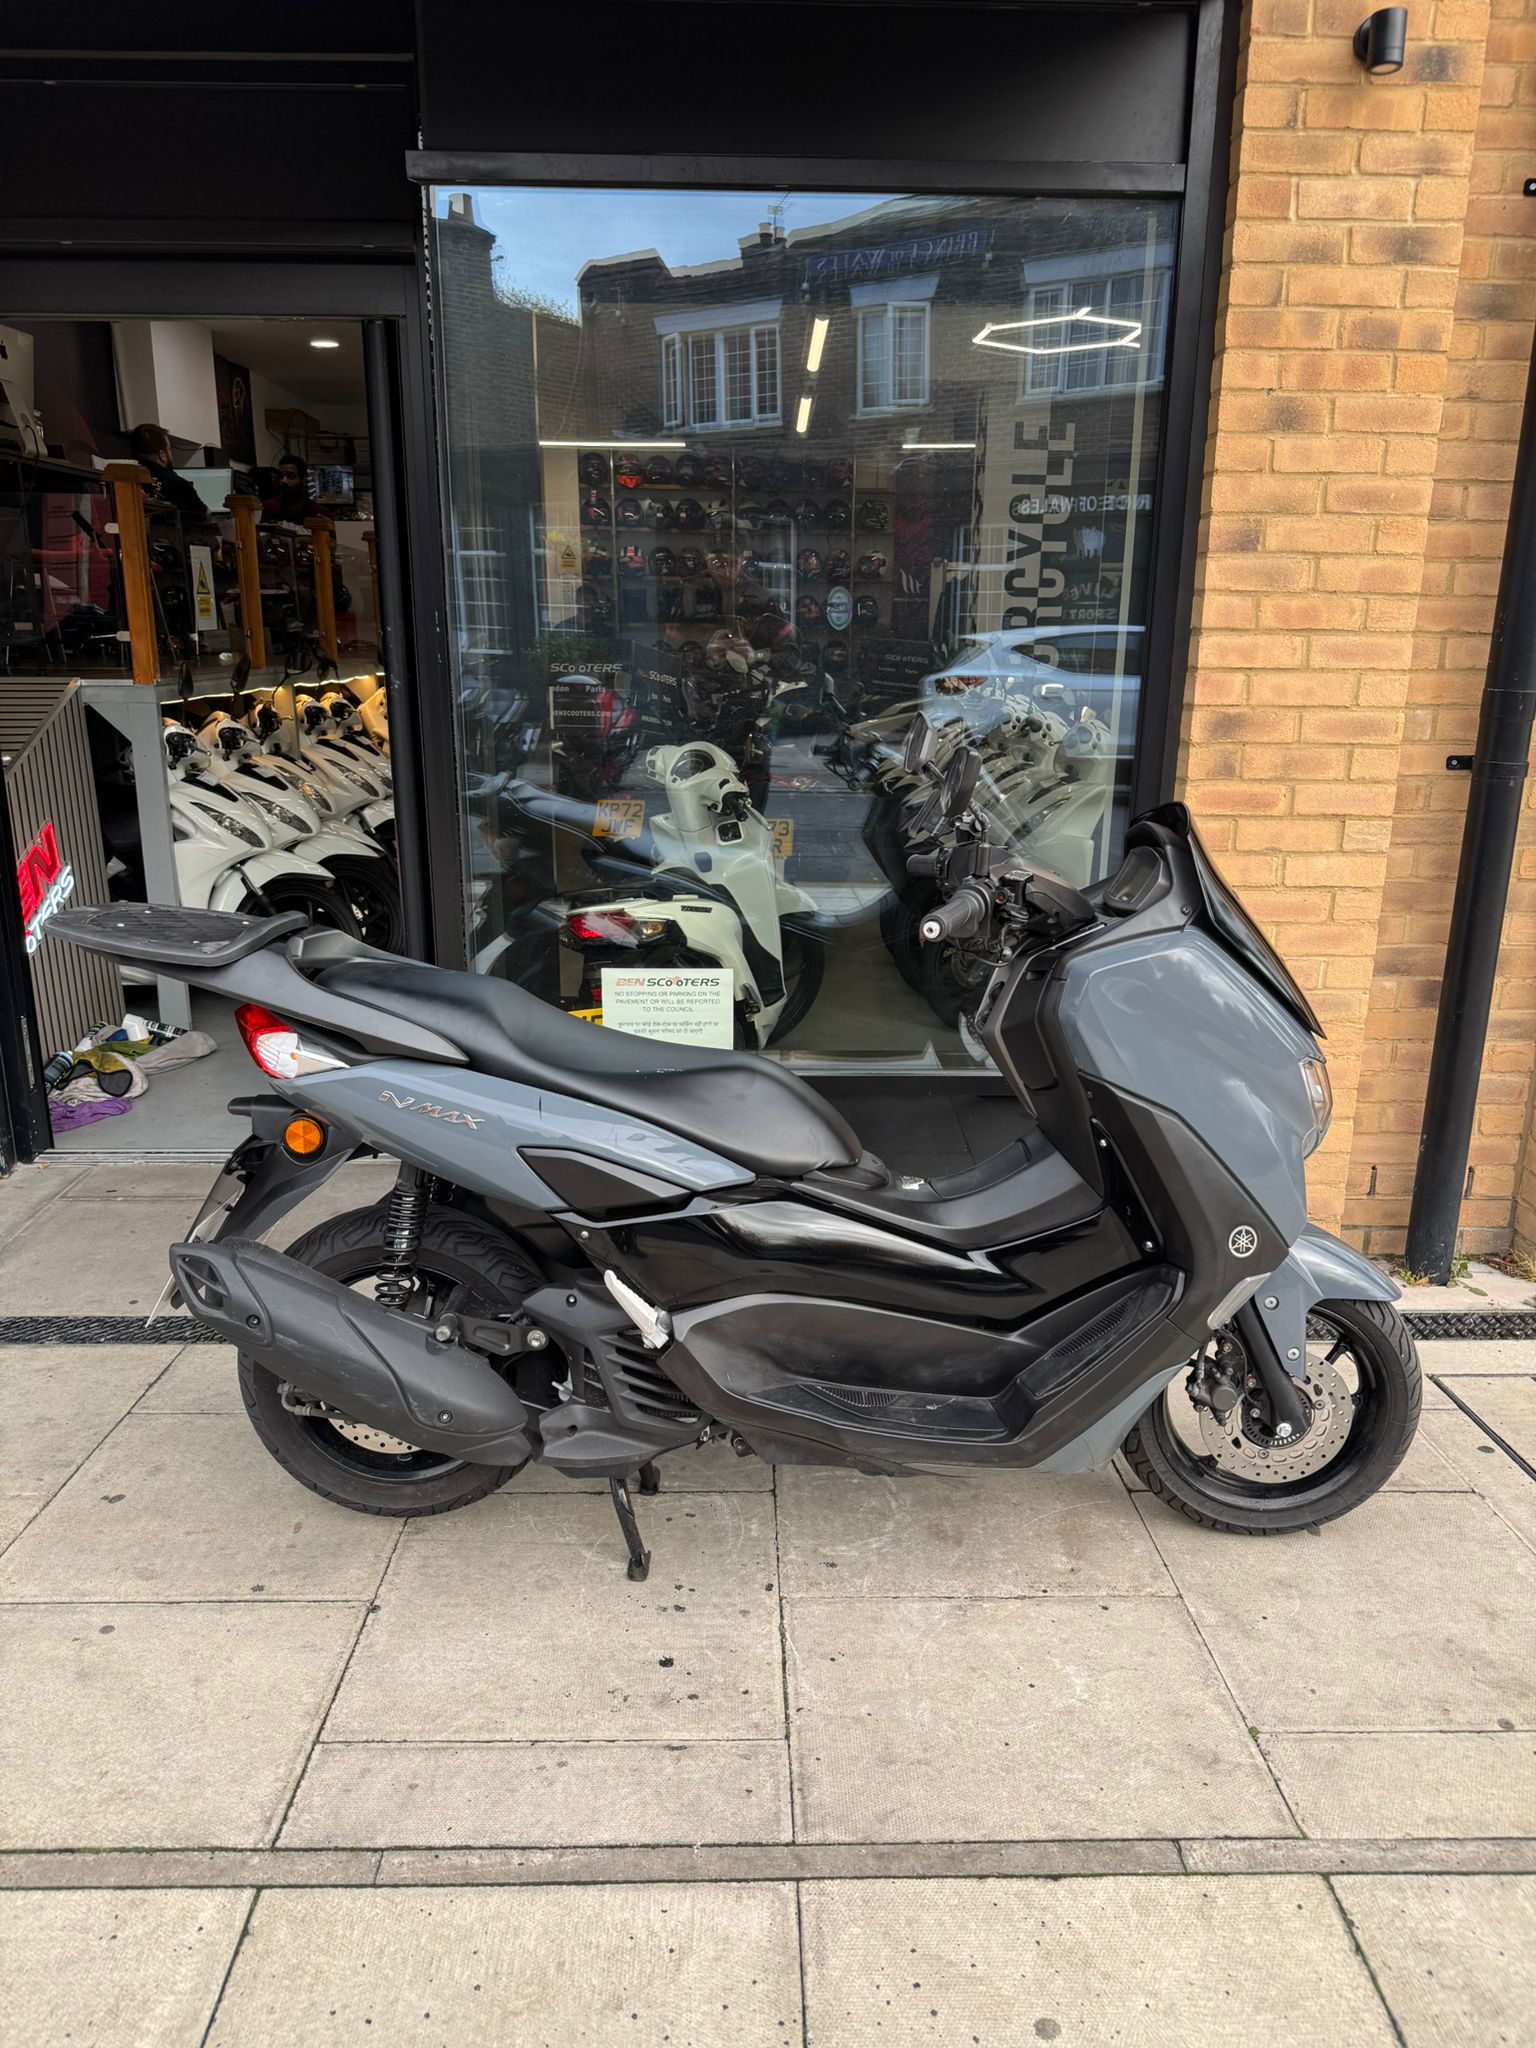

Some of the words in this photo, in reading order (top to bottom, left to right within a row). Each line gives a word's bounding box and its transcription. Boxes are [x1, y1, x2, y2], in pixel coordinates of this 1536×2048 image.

[585, 685, 606, 693] Paris
[599, 801, 644, 818] KP72
[615, 977, 646, 987] BEN
[378, 1089, 485, 1130] NMAX
